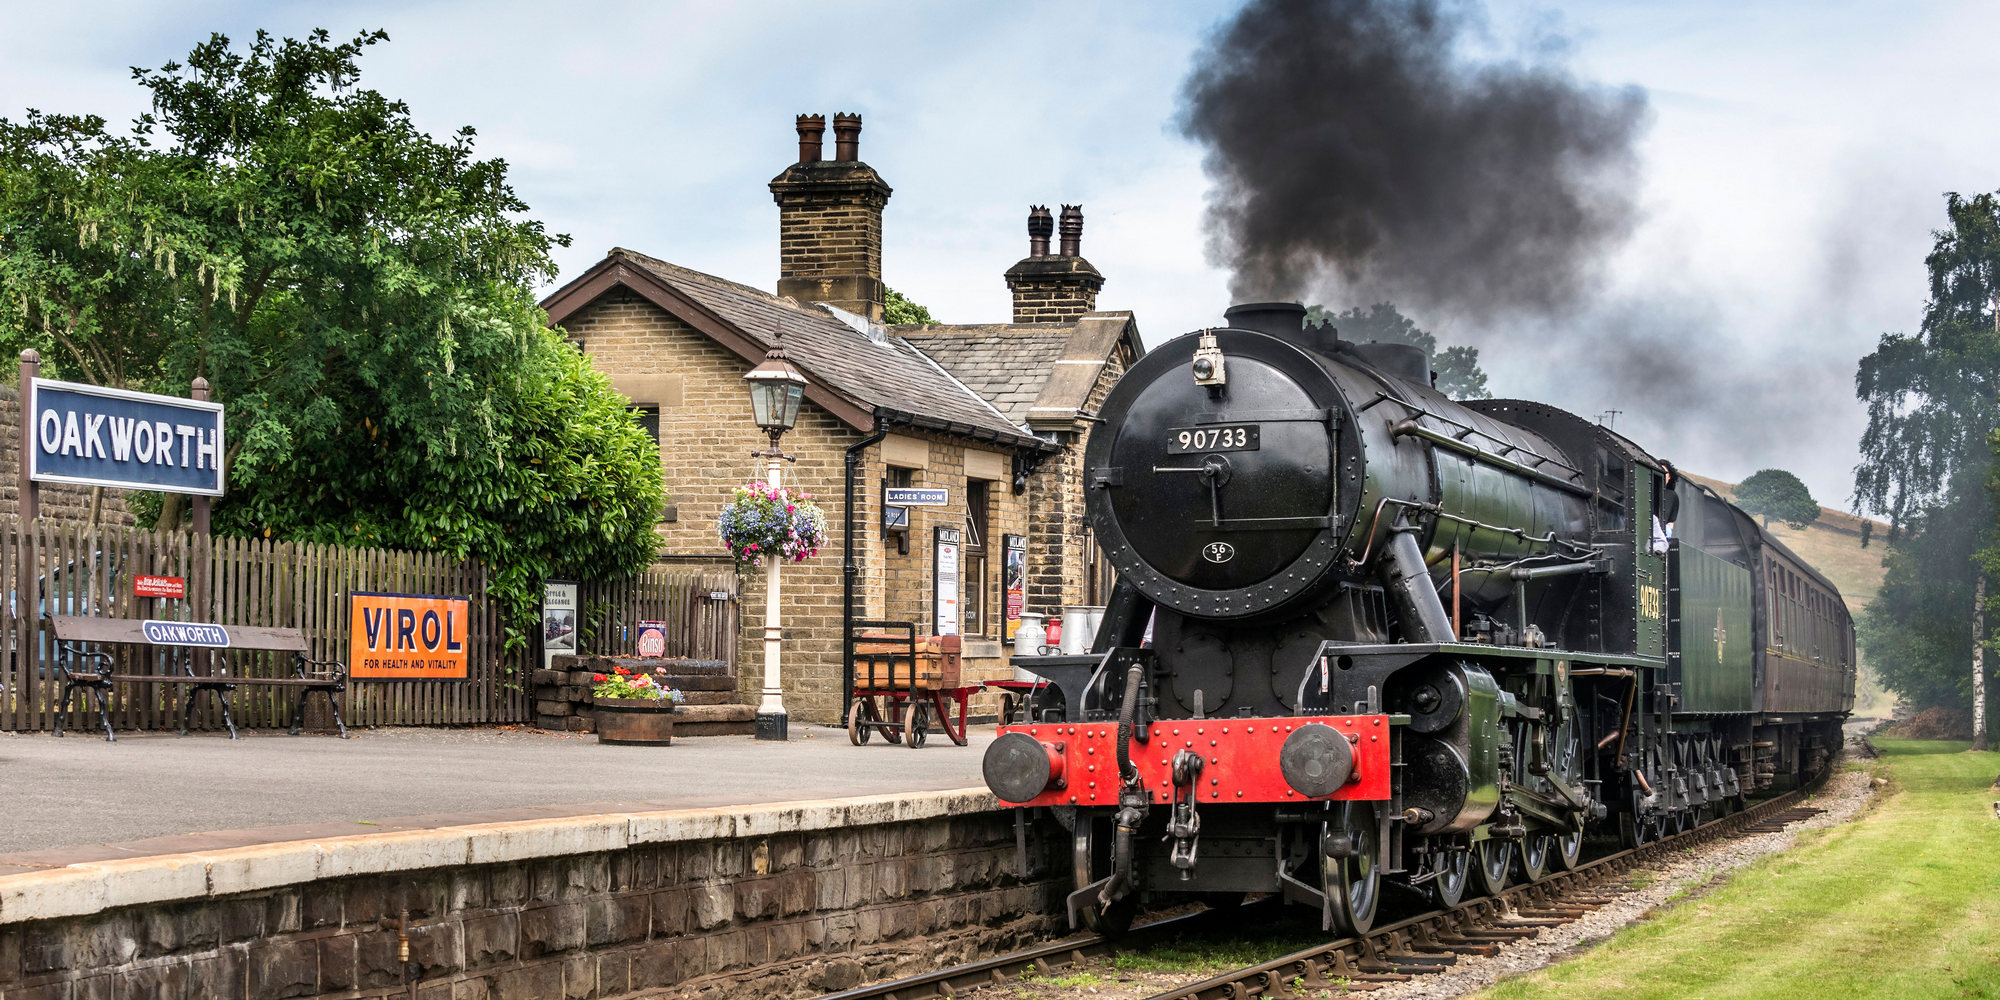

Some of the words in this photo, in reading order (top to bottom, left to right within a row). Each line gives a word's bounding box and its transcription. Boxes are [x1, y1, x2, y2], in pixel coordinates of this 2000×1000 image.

[40, 408, 218, 470] OAKWORTH
[1178, 428, 1247, 450] 90733
[888, 491, 920, 500] LADIES'
[1211, 544, 1226, 554] 56
[1216, 553, 1222, 562] F
[1640, 584, 1659, 620] 90733
[151, 626, 222, 643] OAKWORTH
[363, 607, 463, 653] VIROL
[641, 632, 664, 654] Rinso
[364, 658, 380, 669] FOR
[382, 659, 409, 669] HEALTH
[411, 659, 425, 669] AND
[428, 660, 457, 670] VITALITY
